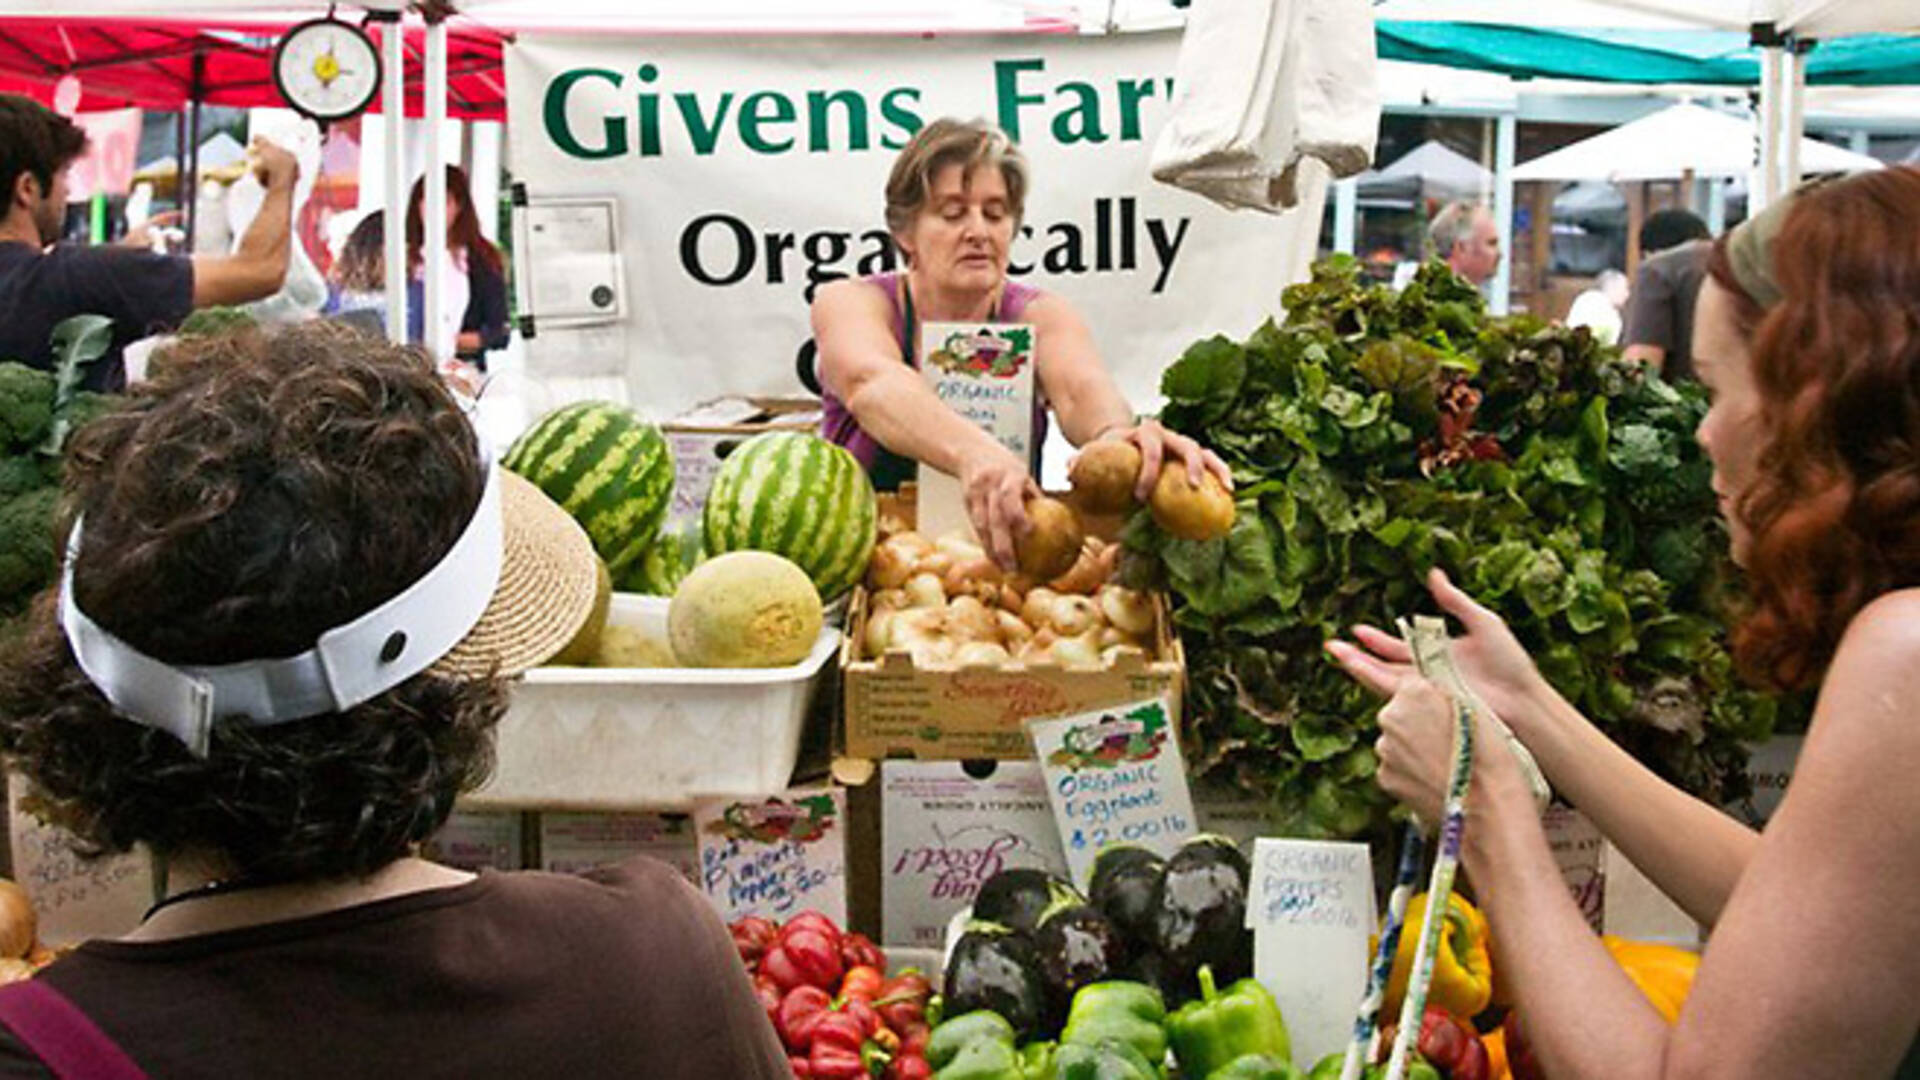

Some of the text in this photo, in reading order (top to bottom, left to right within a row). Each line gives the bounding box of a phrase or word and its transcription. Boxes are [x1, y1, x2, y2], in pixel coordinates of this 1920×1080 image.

[543, 58, 1175, 160] Givens Far
[1058, 764, 1162, 798] ORGANIC
